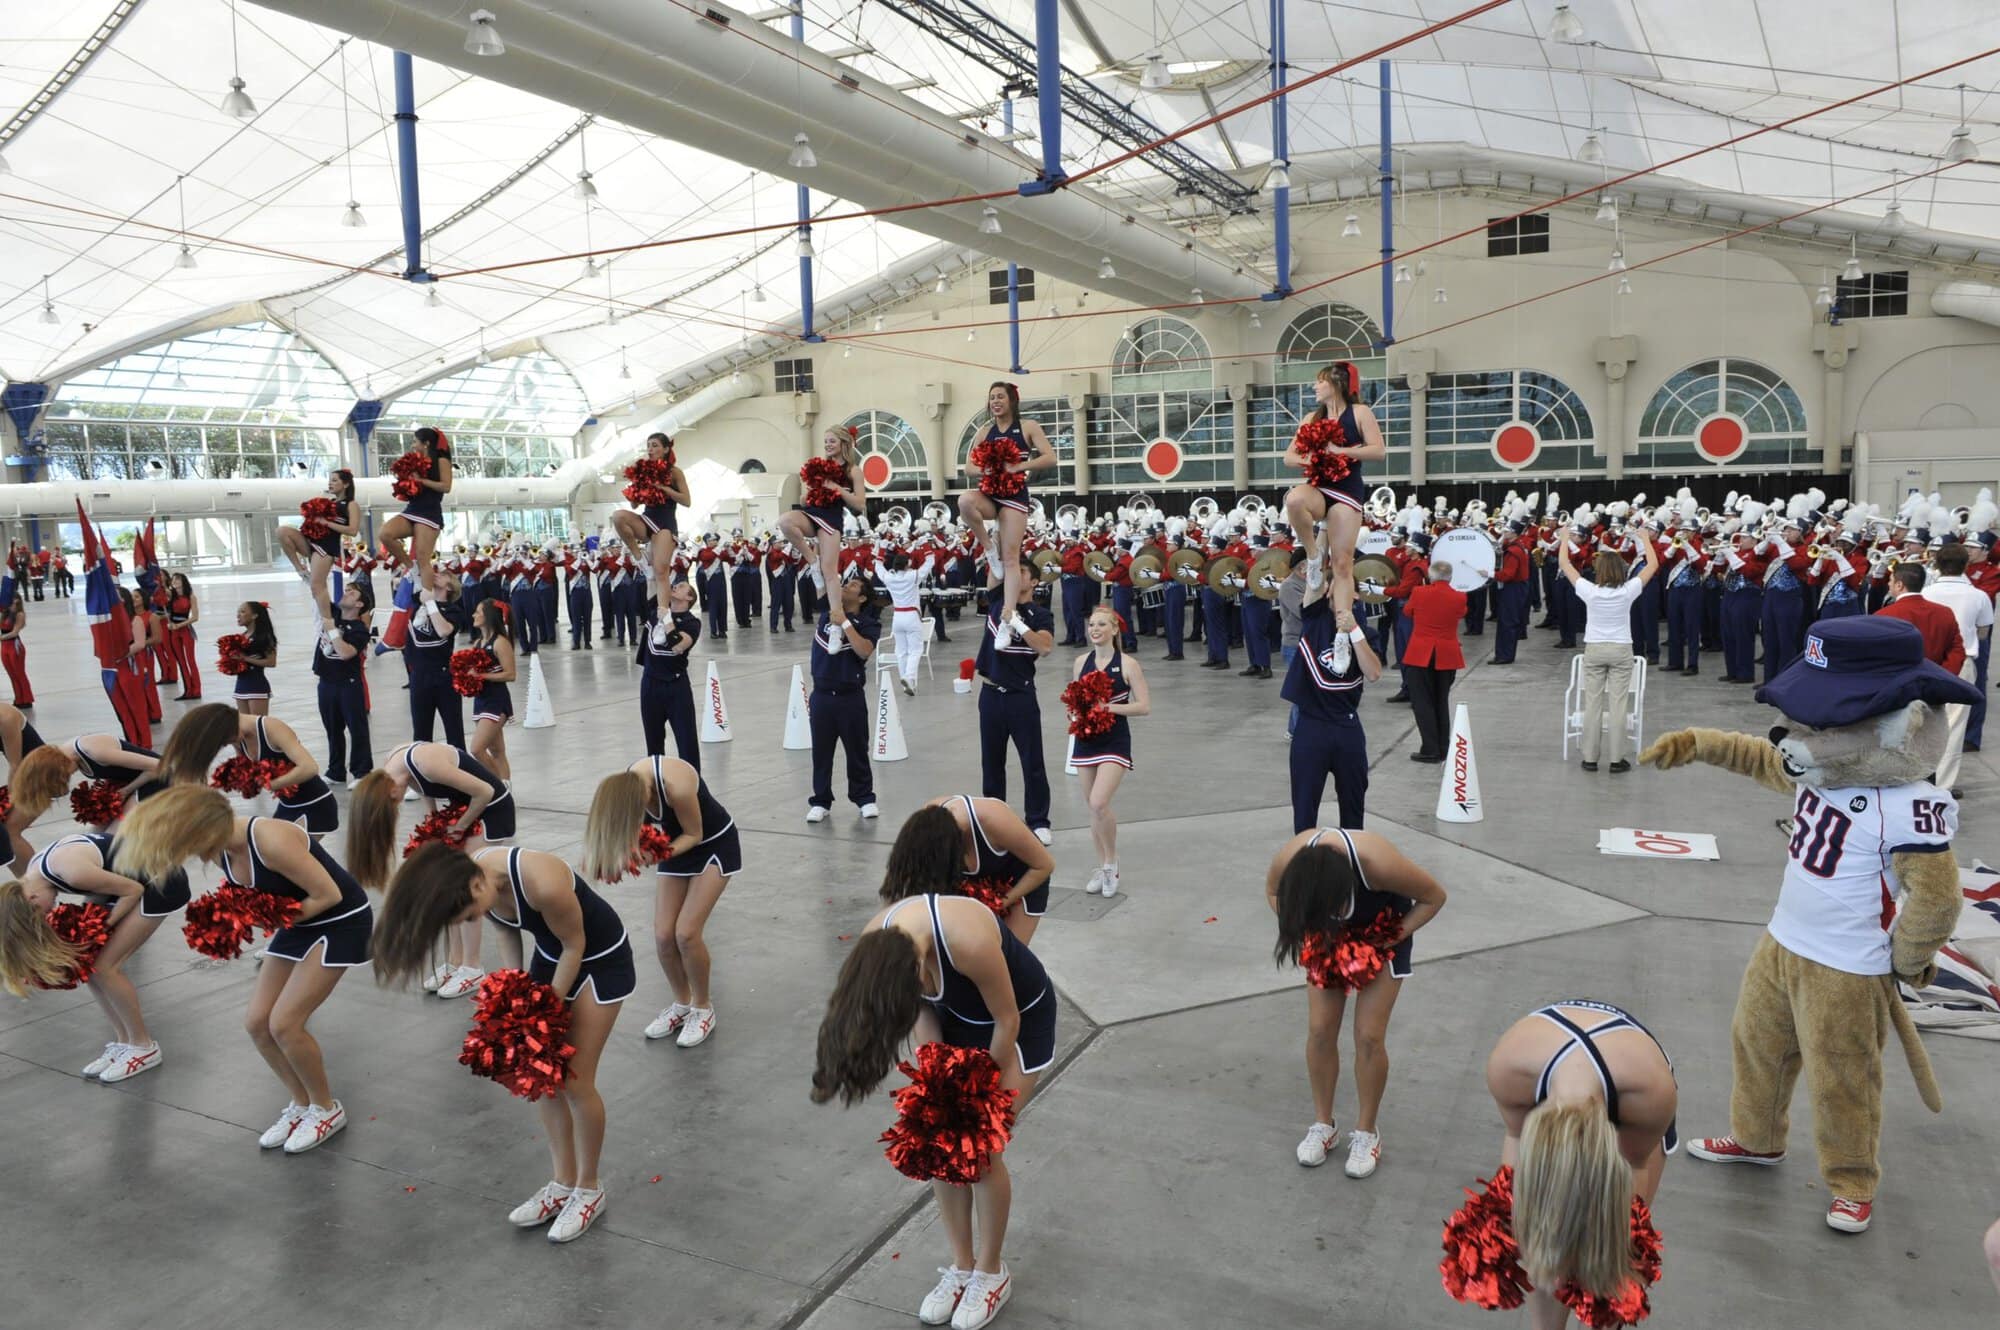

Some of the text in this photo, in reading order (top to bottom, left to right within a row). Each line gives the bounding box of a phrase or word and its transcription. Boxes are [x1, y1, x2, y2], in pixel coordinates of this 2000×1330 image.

[1805, 634, 1828, 668] A
[710, 676, 723, 724] ARIZONA
[1454, 733, 1468, 802] ARIZONA
